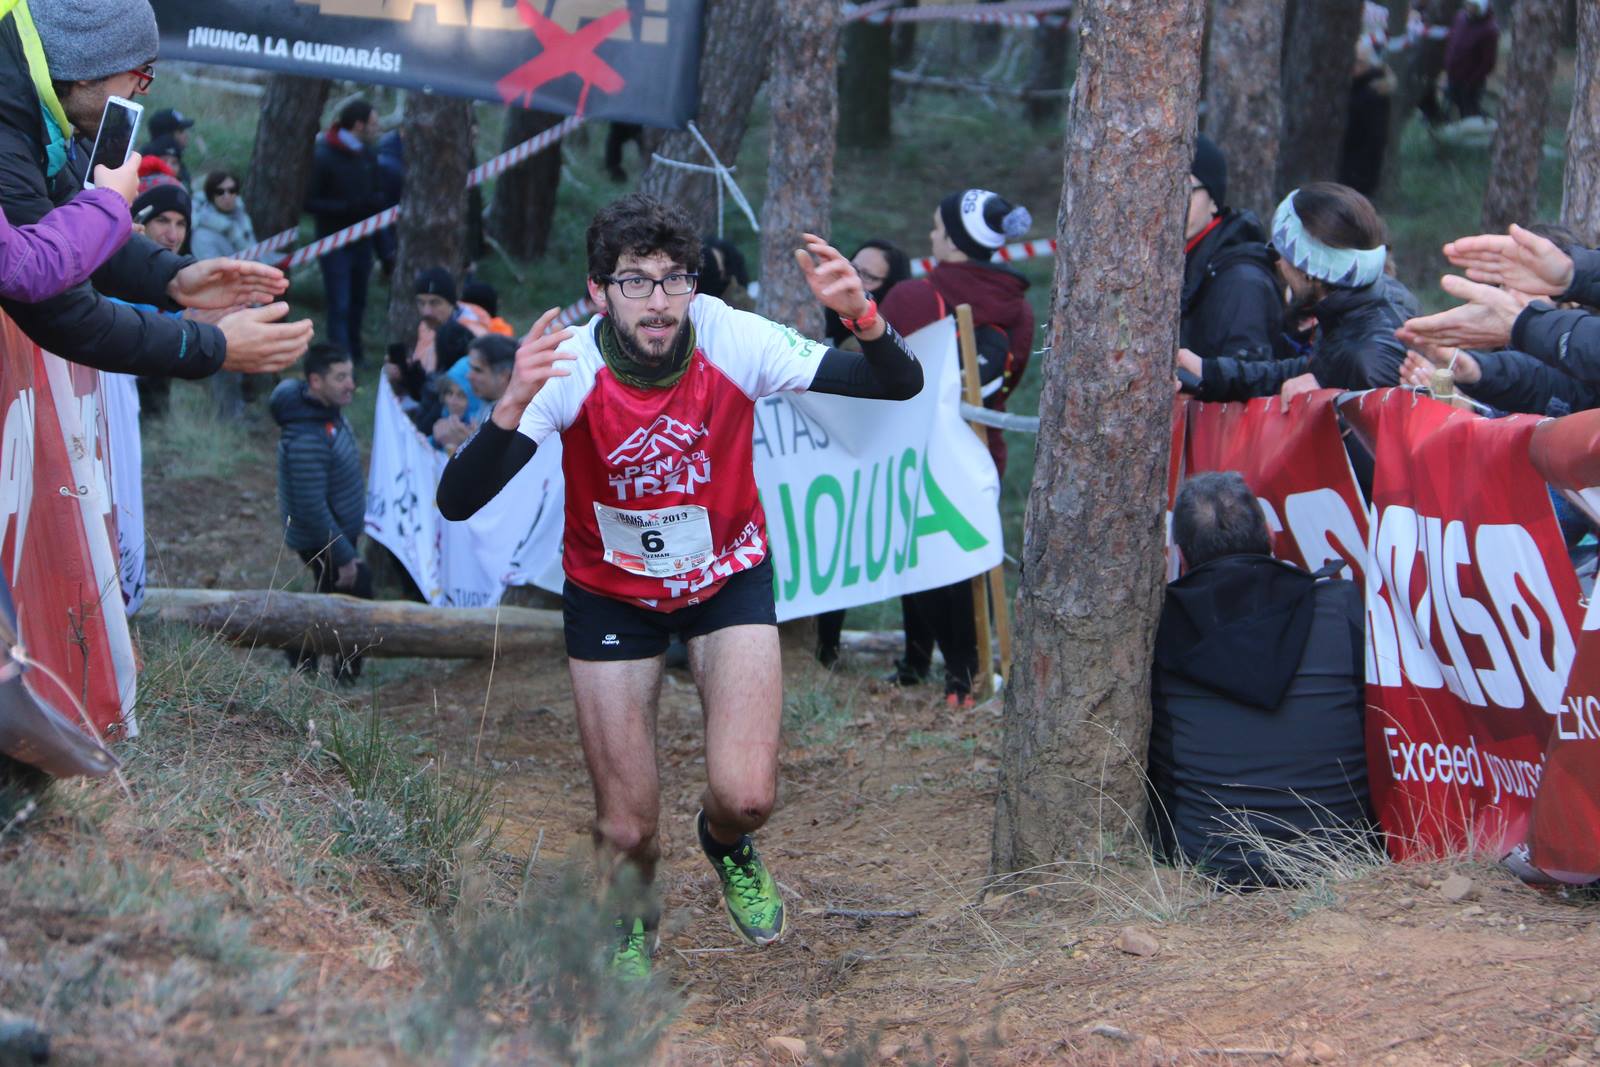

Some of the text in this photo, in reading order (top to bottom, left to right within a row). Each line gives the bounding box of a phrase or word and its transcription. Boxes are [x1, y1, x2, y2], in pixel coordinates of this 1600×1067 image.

[187, 26, 402, 73] ¡NUNCA LA OLVIDARÁS!
[640, 530, 665, 553] 6
[1557, 694, 1600, 740] Exc
[1384, 727, 1546, 804] Exceed yours
